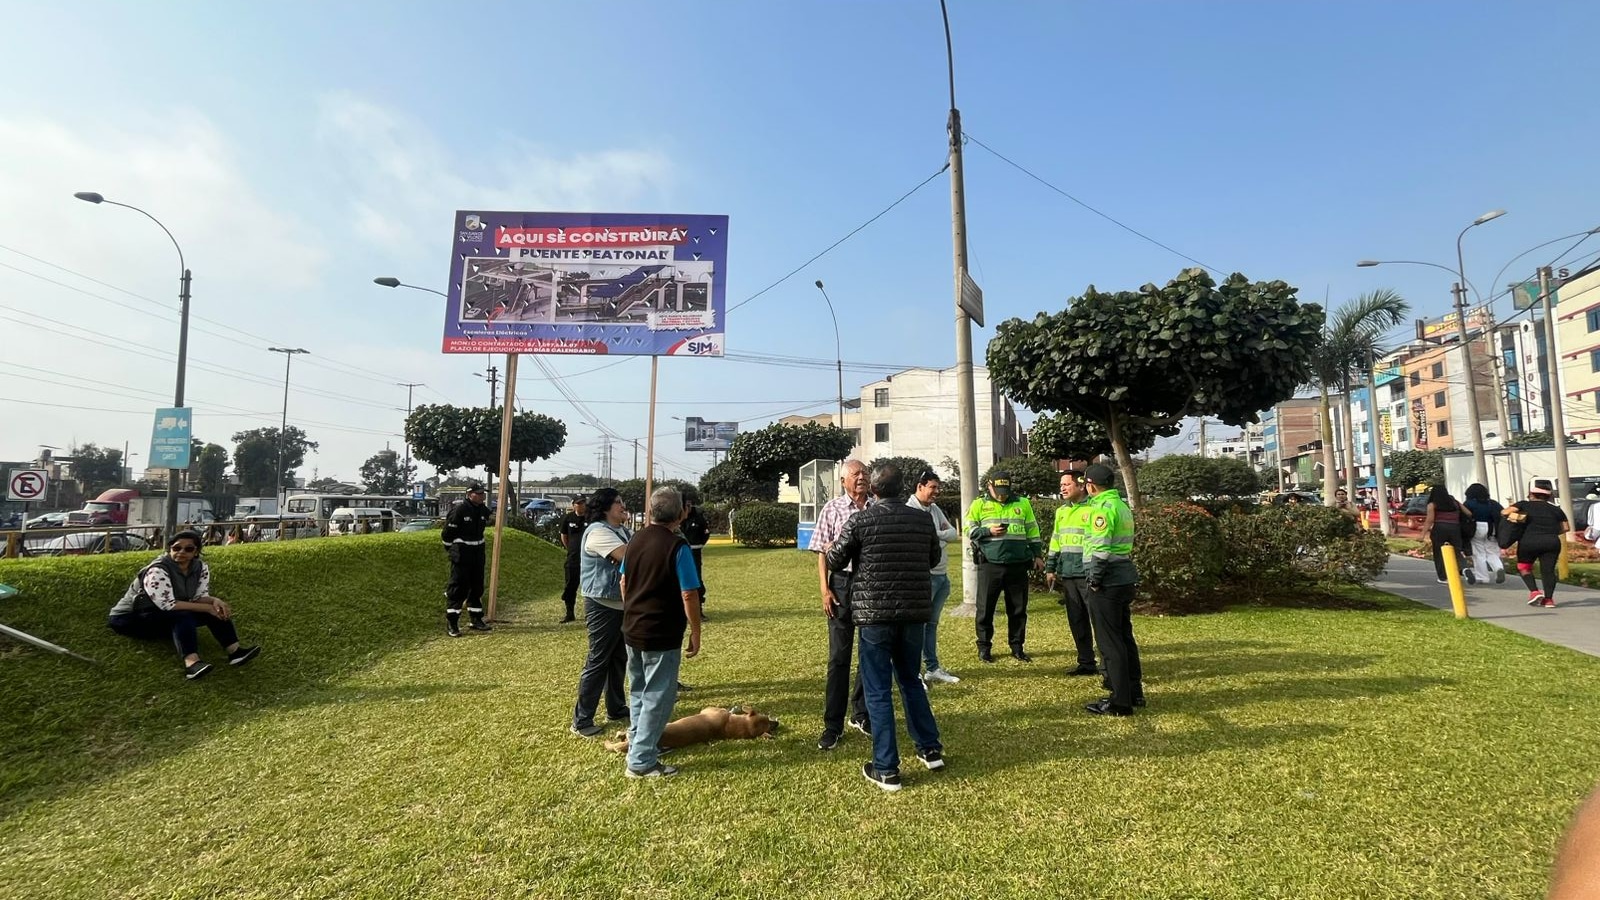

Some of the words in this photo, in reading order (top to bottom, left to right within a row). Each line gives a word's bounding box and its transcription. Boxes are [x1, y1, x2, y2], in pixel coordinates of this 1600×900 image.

[501, 233, 543, 244] AQUI
[547, 232, 566, 243] SE
[569, 228, 682, 243] CONSTRUIRÁ
[520, 249, 580, 260] PUENTE
[586, 249, 669, 260] PEATONAL
[688, 342, 712, 354] SJM
